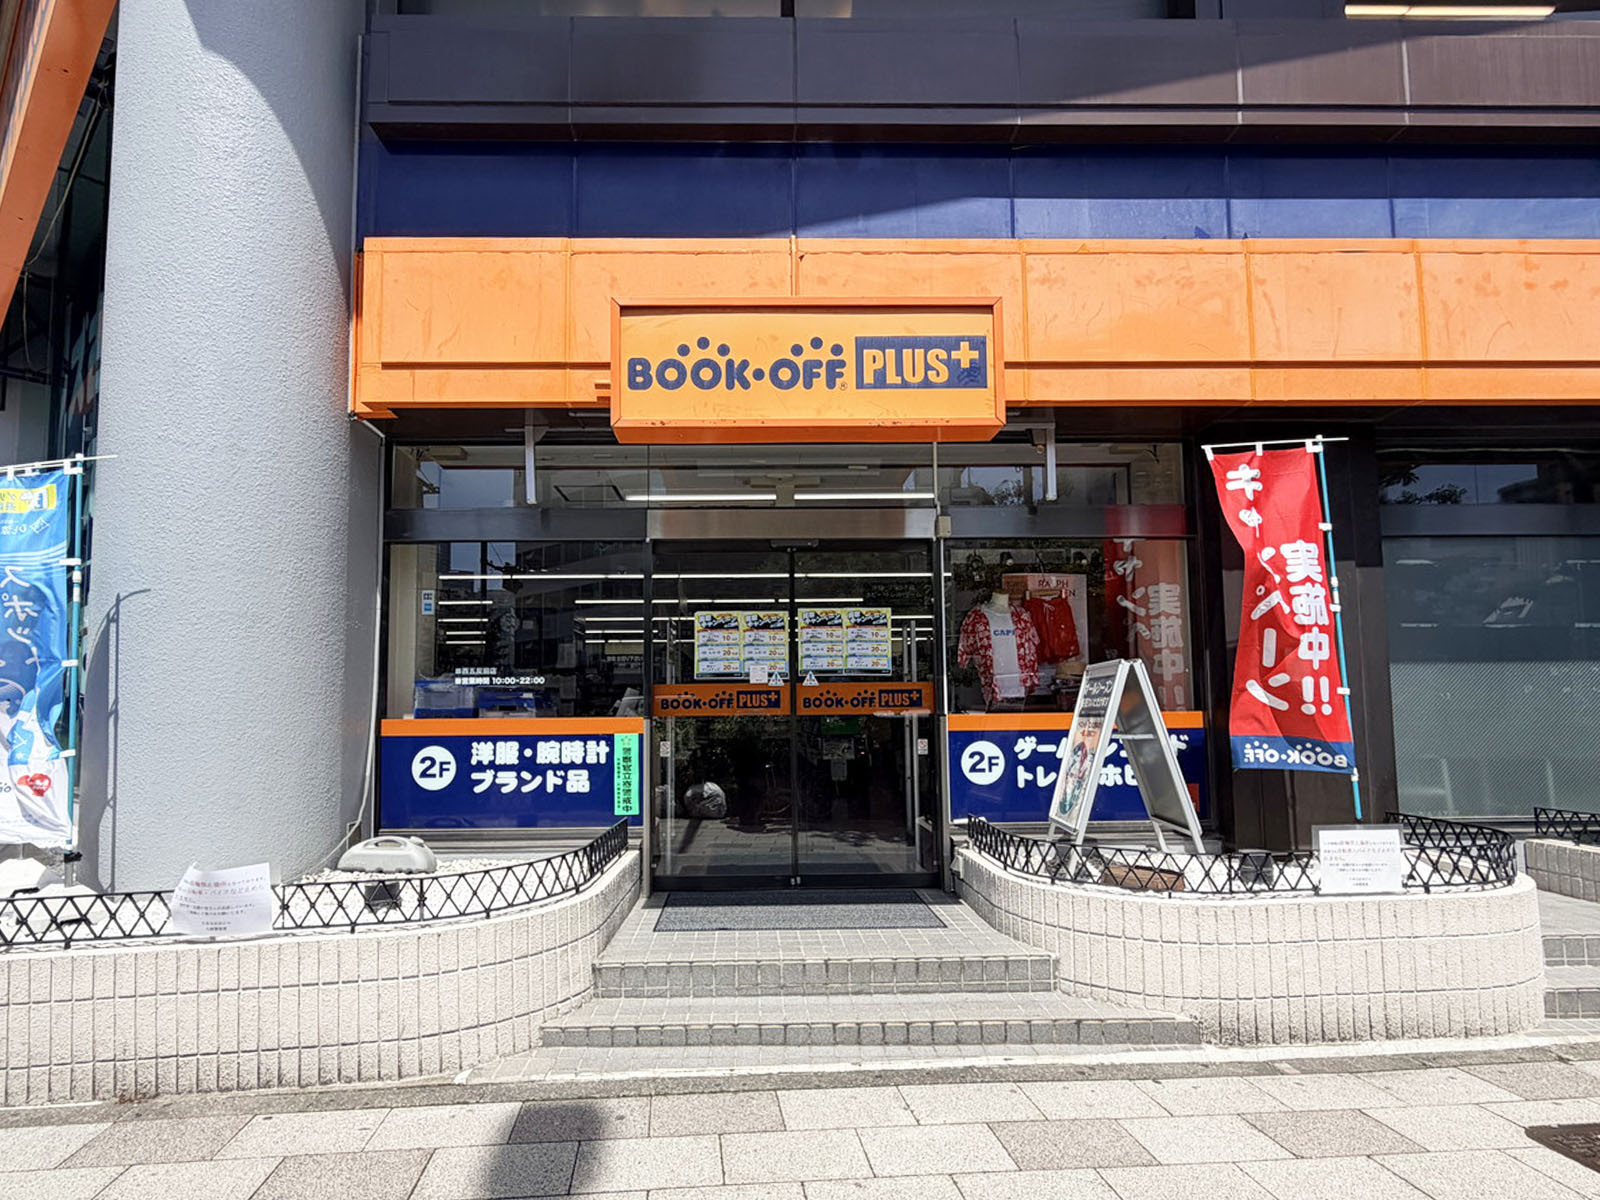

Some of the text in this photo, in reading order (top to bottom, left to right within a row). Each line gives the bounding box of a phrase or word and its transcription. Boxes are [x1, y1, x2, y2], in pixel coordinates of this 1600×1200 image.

[1038, 579, 1069, 587] RAPH
[418, 756, 452, 779] 2F
[968, 751, 1000, 774] 2F
[471, 769, 591, 794] ブランド品
